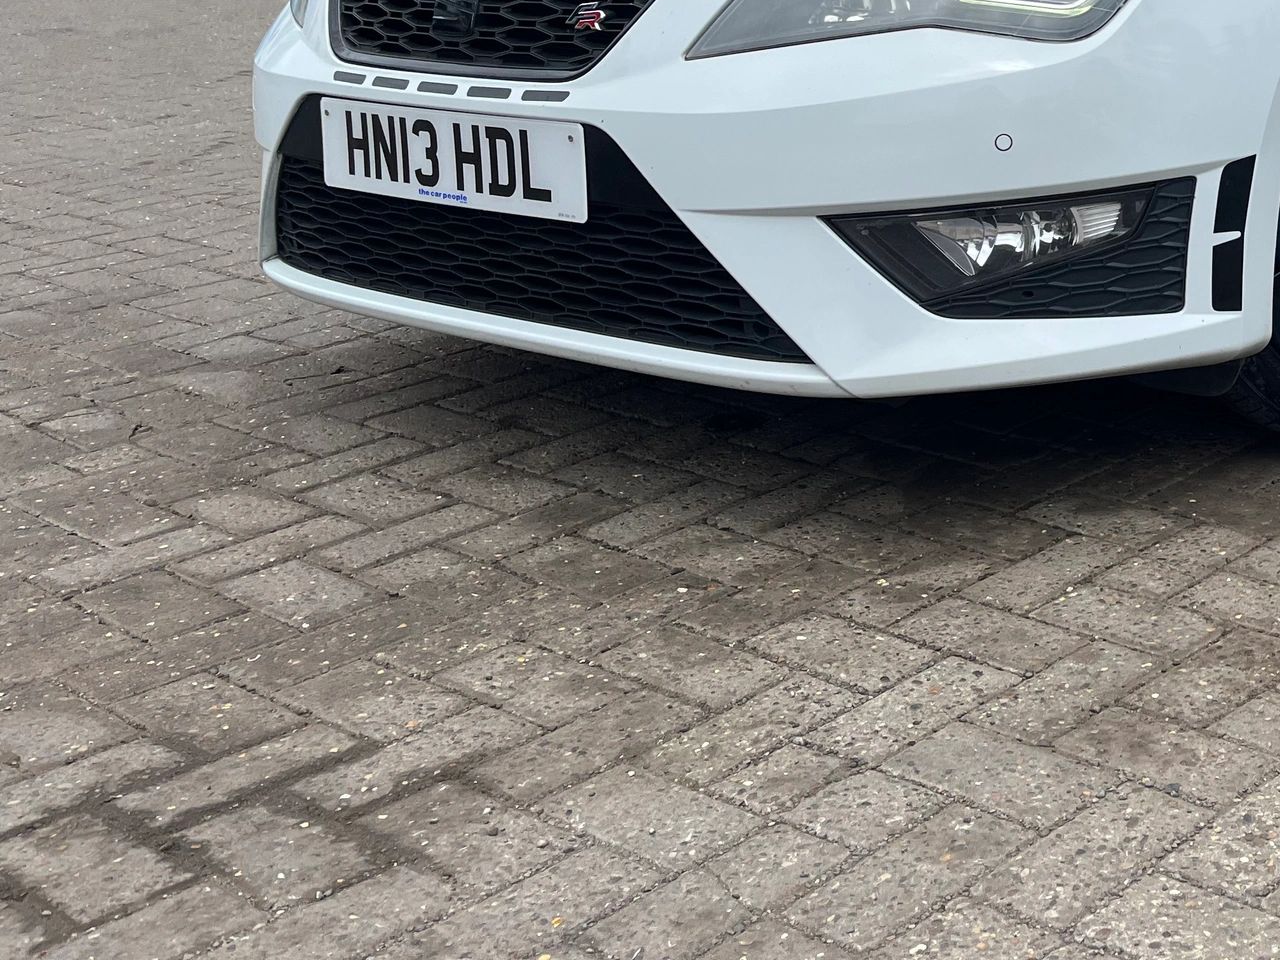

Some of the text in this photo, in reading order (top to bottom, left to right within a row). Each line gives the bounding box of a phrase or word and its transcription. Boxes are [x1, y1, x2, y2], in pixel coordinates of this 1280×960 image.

[345, 110, 552, 203] HN13 HDL
[418, 188, 430, 196] the
[442, 193, 468, 202] people
